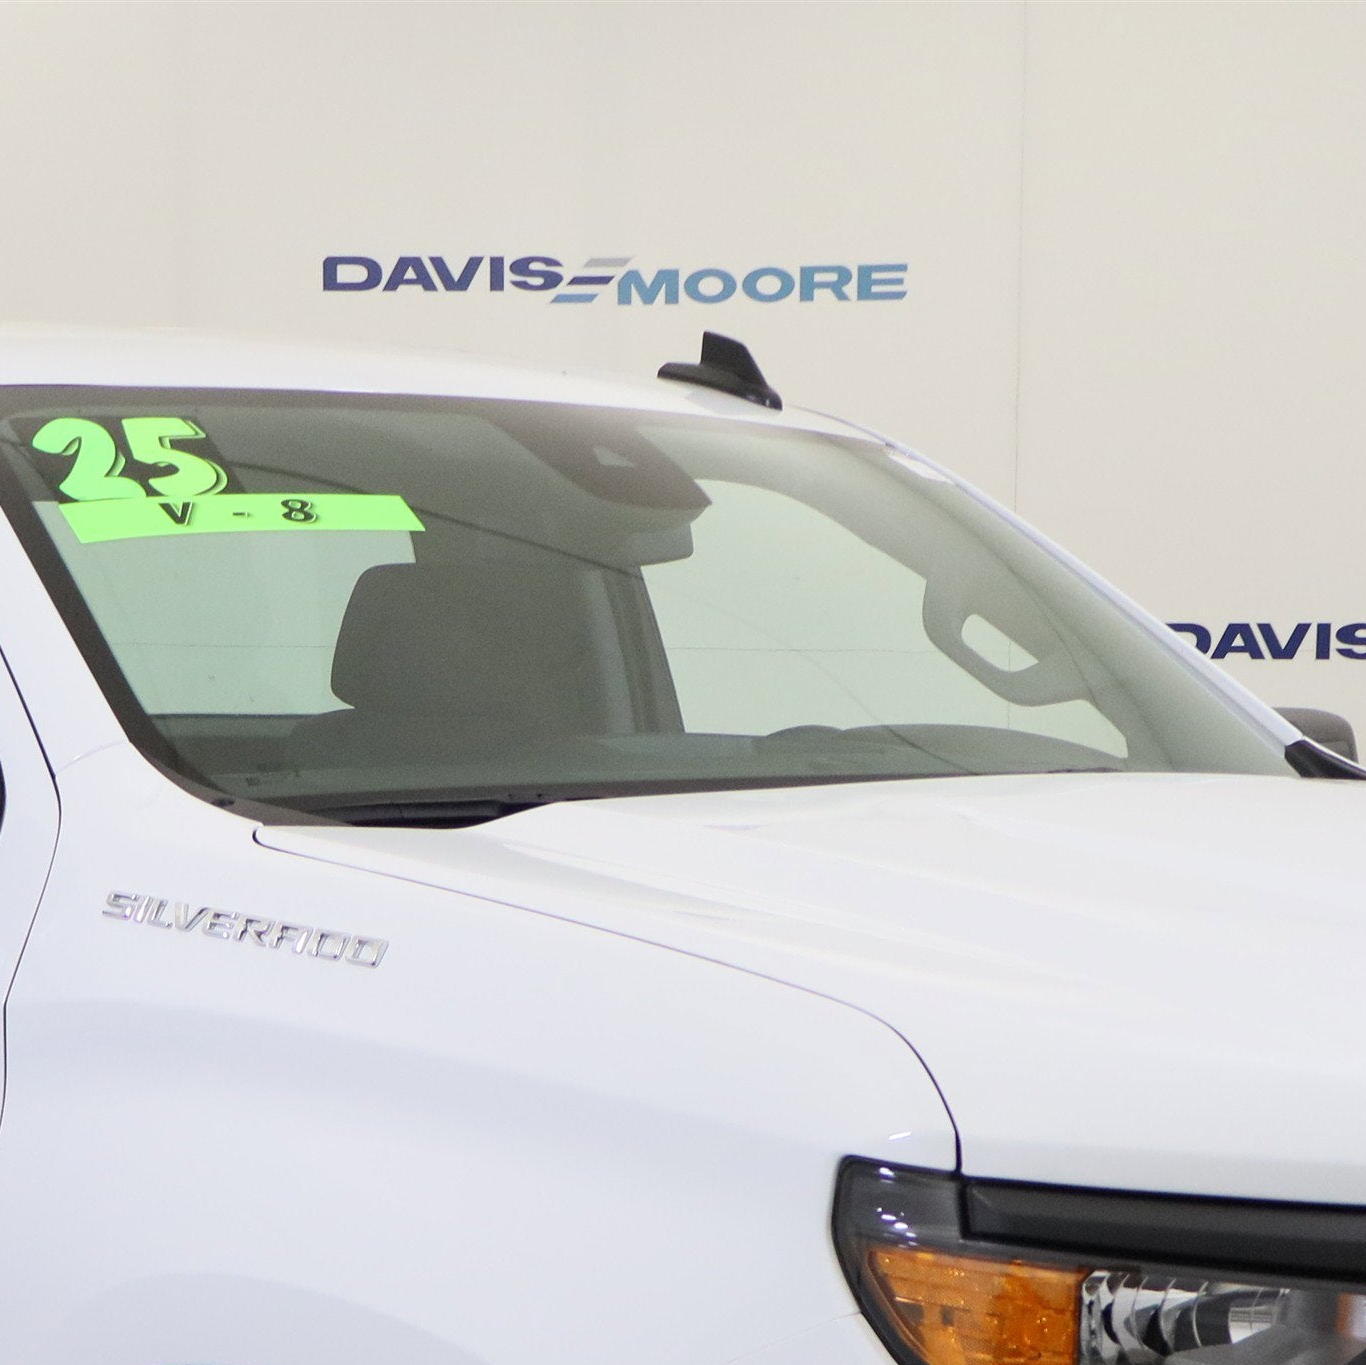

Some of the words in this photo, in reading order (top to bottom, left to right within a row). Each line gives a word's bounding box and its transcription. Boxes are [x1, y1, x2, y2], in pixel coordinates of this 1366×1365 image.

[322, 256, 563, 292] DAVIS
[617, 263, 908, 305] MOORE
[32, 416, 228, 500] 25
[101, 889, 390, 969] SILVERADO
